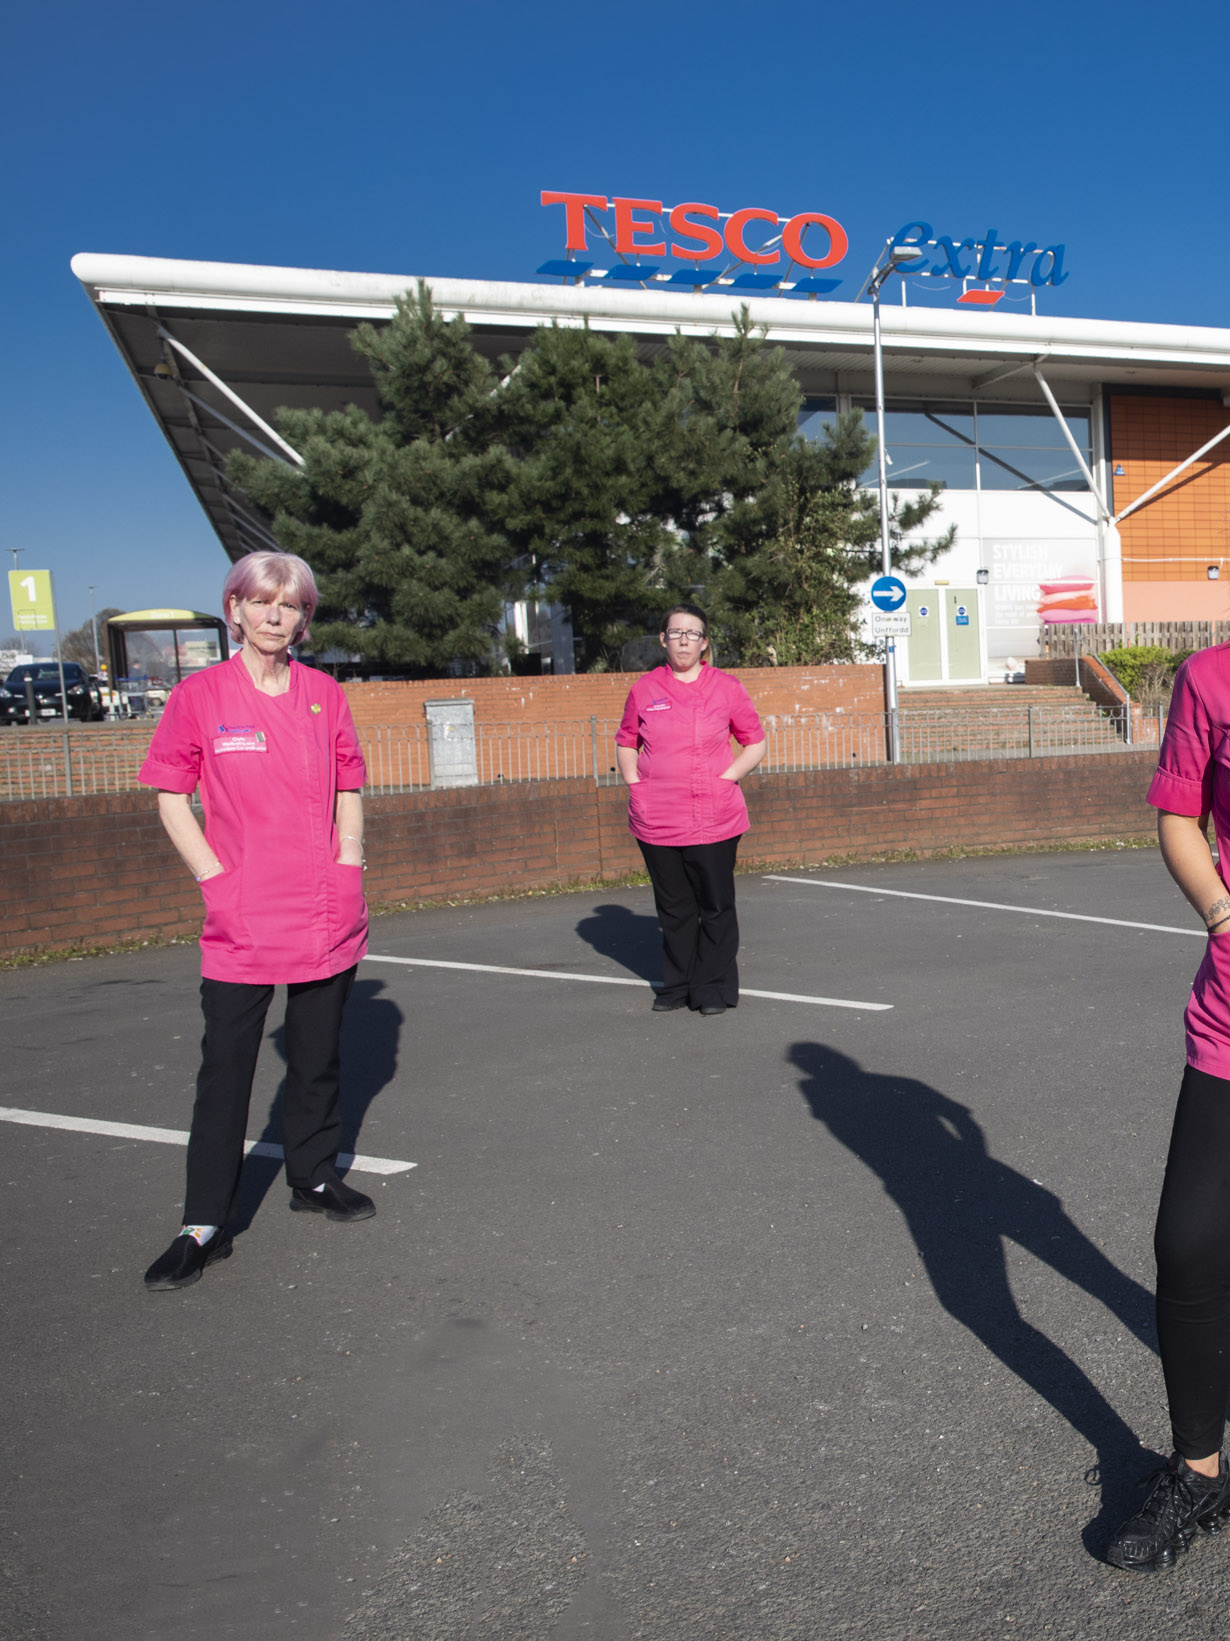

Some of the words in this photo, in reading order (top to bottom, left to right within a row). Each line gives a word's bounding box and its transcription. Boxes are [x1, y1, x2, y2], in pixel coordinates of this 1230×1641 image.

[540, 190, 849, 269] TESCO
[890, 220, 1070, 287] extra
[992, 543, 1048, 560] STYLISH
[993, 562, 1063, 578] EVERYDAY
[20, 576, 37, 602] 1
[994, 585, 1041, 600] LIVING
